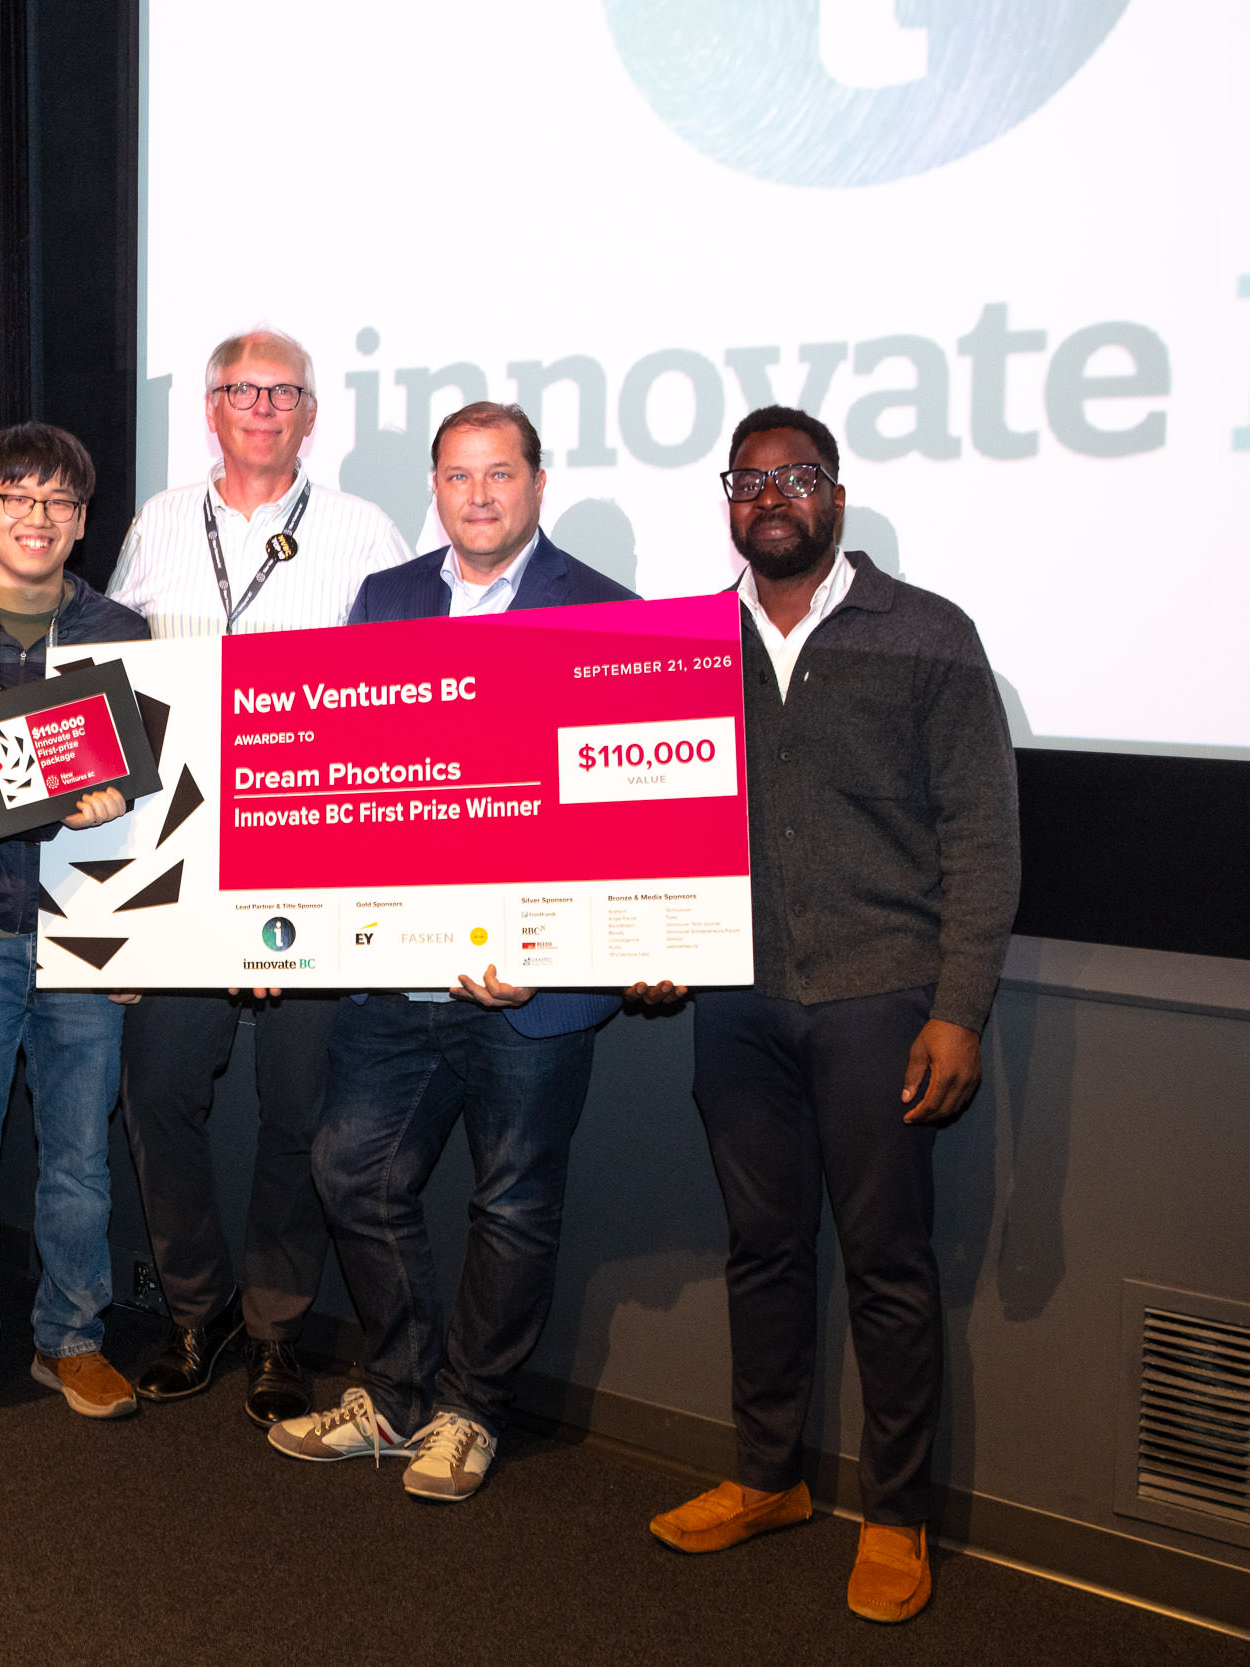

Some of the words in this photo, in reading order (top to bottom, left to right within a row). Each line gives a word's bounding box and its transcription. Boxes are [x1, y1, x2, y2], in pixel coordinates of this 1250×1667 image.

[345, 301, 1172, 470] innovate
[573, 661, 662, 679] SEPTEMBER
[667, 659, 688, 673] 21,
[693, 655, 733, 670] 2026
[234, 687, 295, 714] New
[303, 682, 433, 710] Ventures
[441, 676, 476, 701] BC
[31, 715, 85, 740] $110,000
[34, 732, 72, 749] Innovate
[72, 727, 86, 738] BC
[234, 731, 295, 746] AWARDED
[298, 730, 315, 743] TO
[37, 740, 79, 758] First-prize
[578, 739, 716, 772] $110,000
[40, 752, 76, 769] package
[62, 773, 88, 786] Ventures
[235, 767, 320, 789] Dream
[329, 757, 461, 785] Photonics
[627, 775, 667, 785] VALUE
[234, 805, 320, 828] Innovate
[325, 803, 353, 824] BC
[360, 801, 404, 823] First
[409, 799, 461, 821] Prize
[466, 797, 541, 819] Winner
[664, 893, 697, 901] Sponsors
[355, 933, 374, 945] EY
[401, 932, 454, 944] FASKEN
[243, 958, 297, 970] innovate
[299, 958, 316, 969] BC
